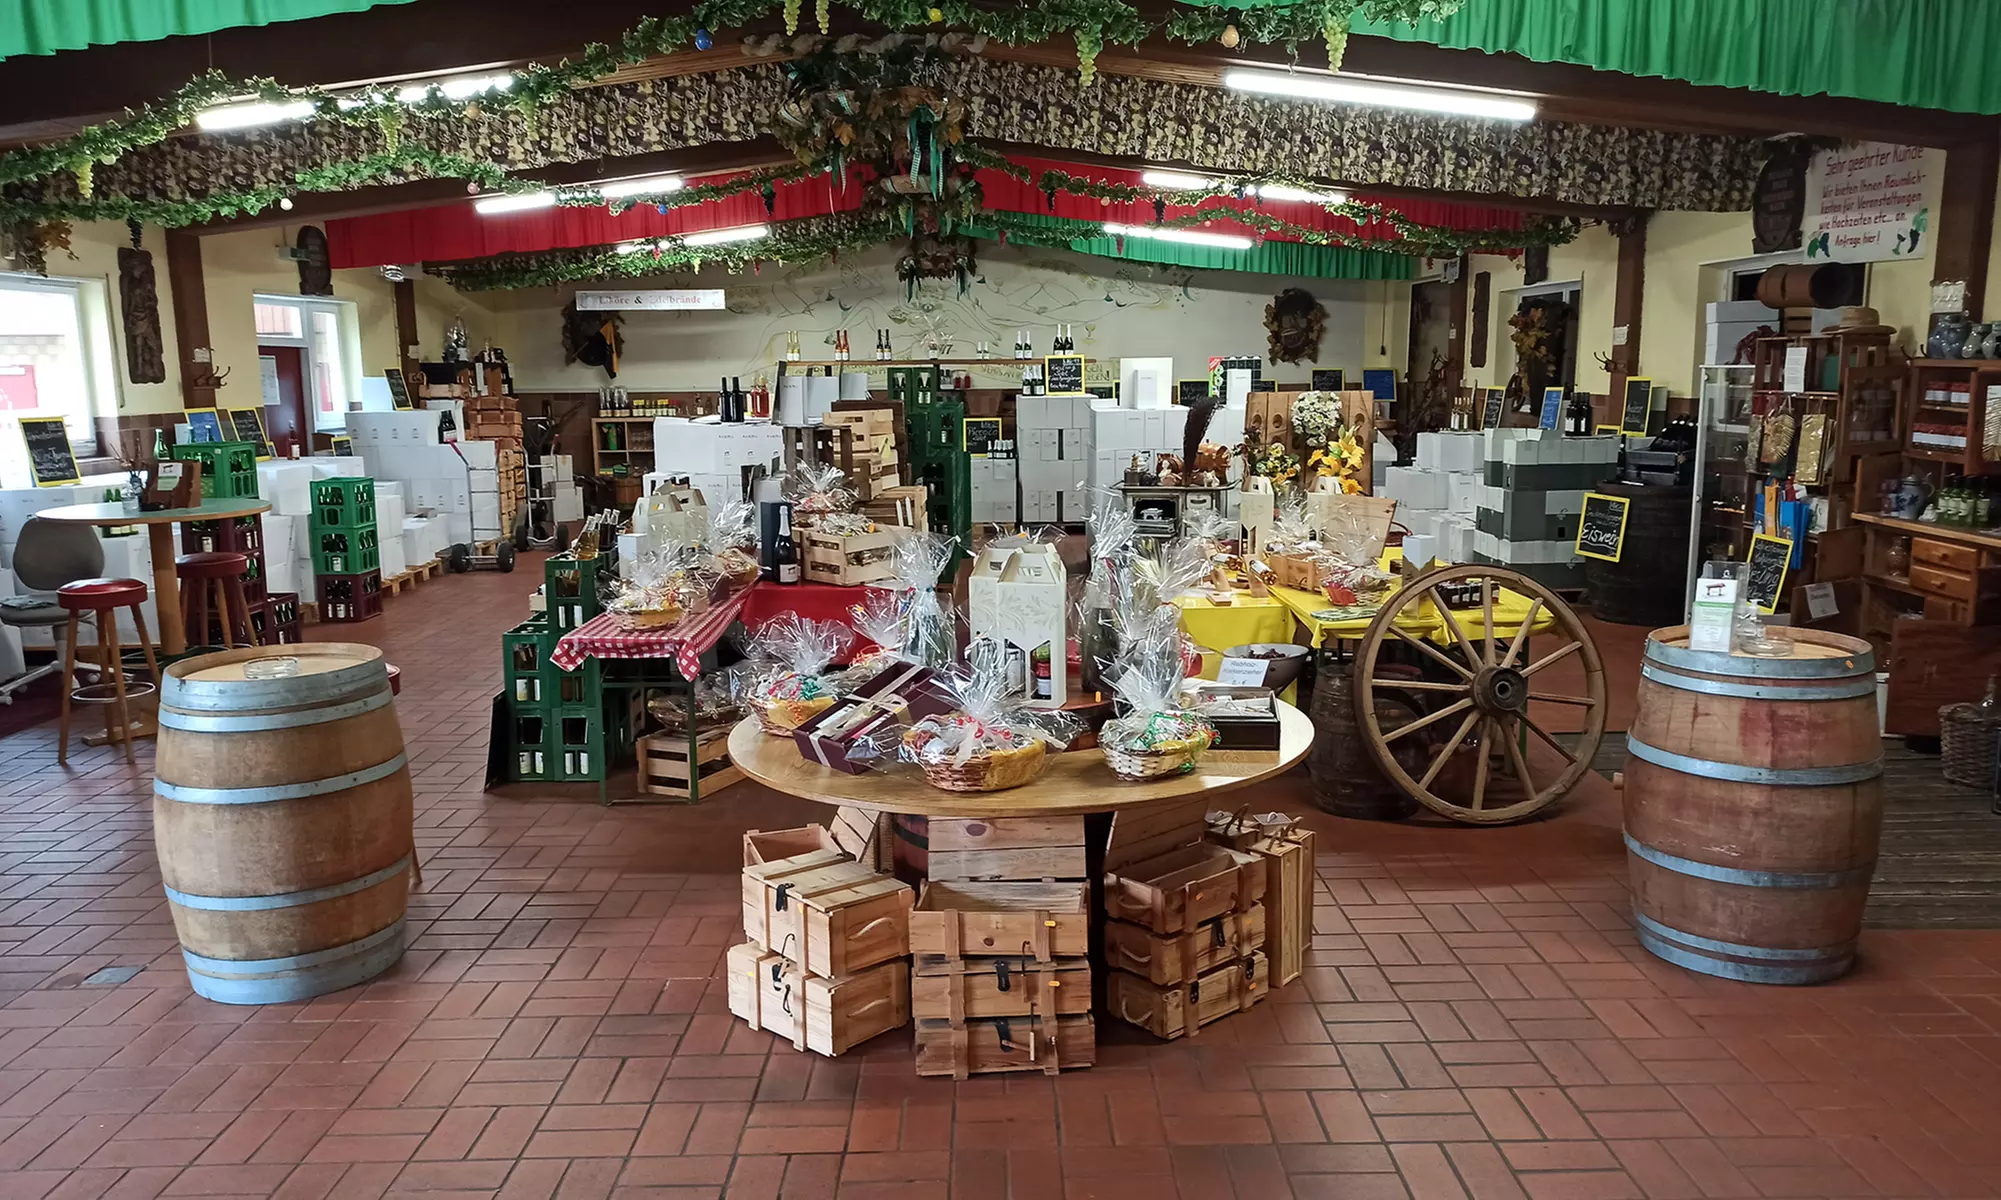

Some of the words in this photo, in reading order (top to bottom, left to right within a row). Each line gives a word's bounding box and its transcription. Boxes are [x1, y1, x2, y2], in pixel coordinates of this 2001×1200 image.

[1825, 154, 1847, 176] Sehr
[1847, 151, 1891, 177] geehrter
[1892, 144, 1924, 163] Kunde
[1822, 183, 1834, 198] Wir
[1835, 181, 1858, 196] bieten
[1860, 179, 1882, 192] Ihnen
[1857, 192, 1922, 209] Veranstaltungen
[1819, 217, 1831, 230] wie
[1831, 212, 1872, 229] Hochzeiten
[1835, 232, 1861, 248] Anfrage
